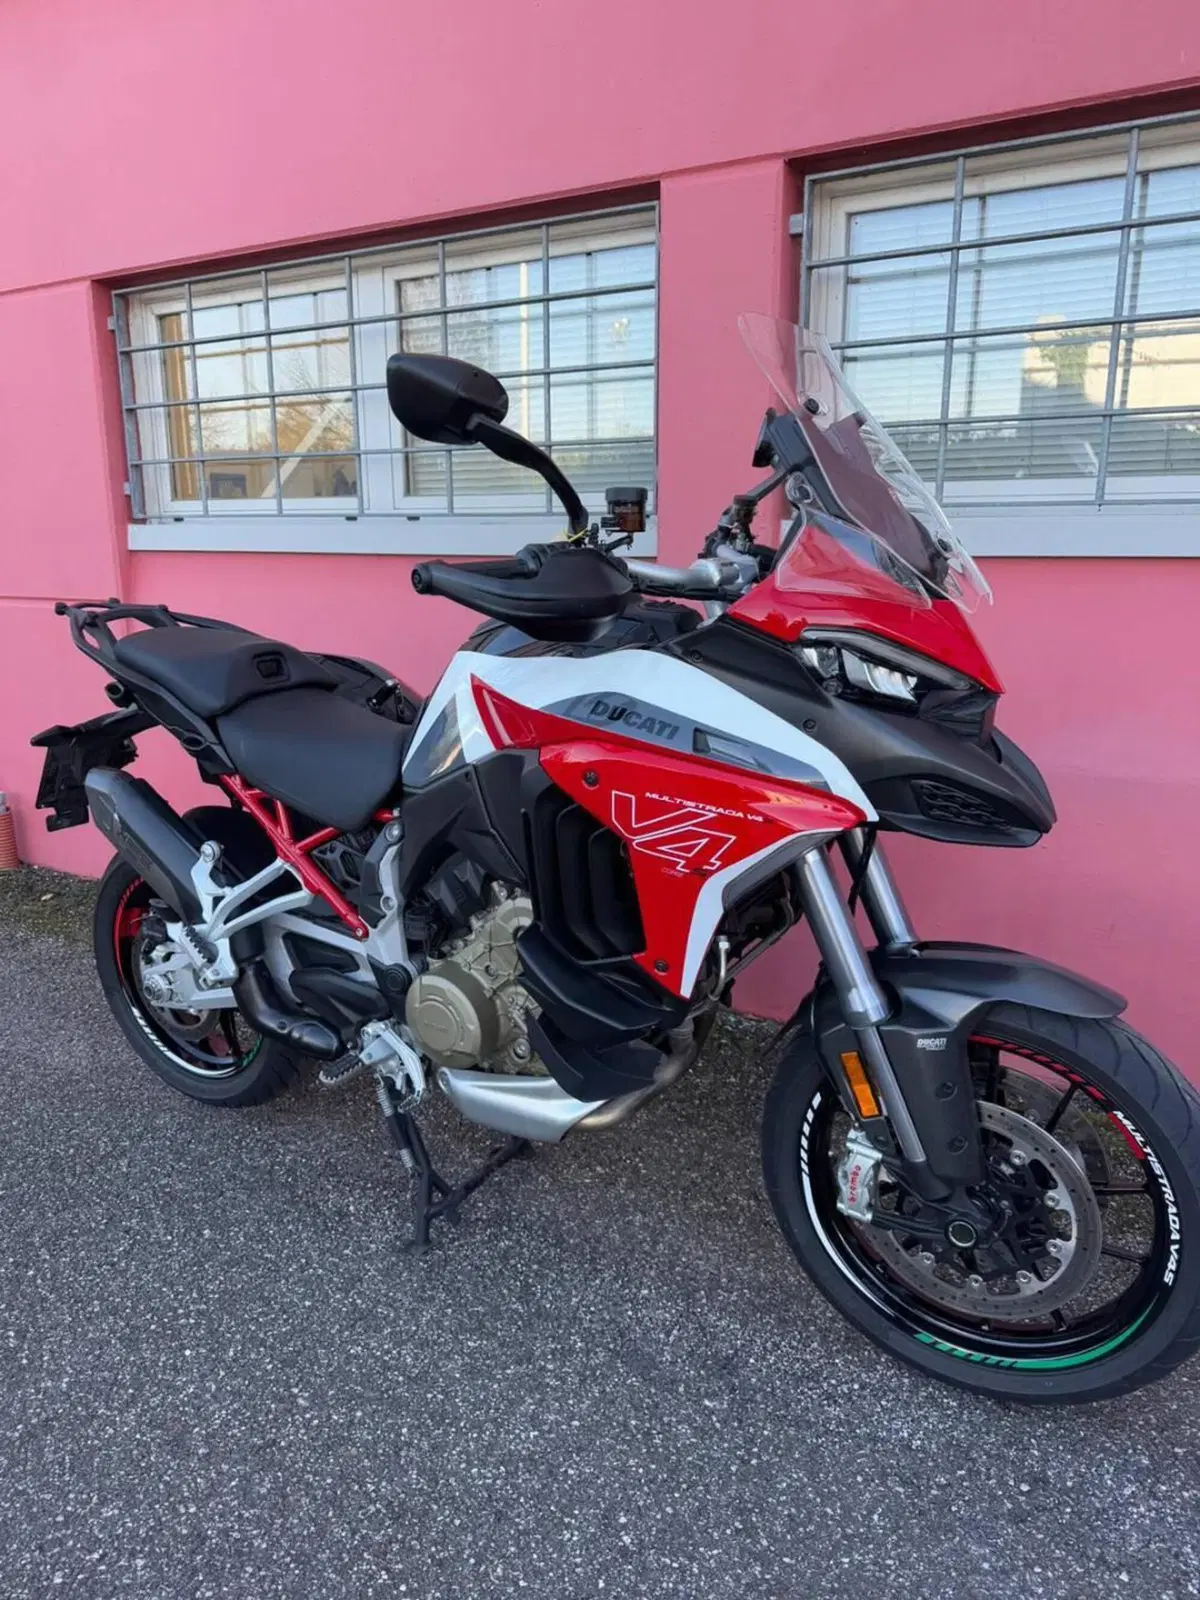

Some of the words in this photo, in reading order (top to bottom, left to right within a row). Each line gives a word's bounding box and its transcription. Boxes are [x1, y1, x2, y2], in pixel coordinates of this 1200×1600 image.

[589, 700, 680, 740] DUCATI
[645, 791, 744, 818] MULTISTRADA
[611, 789, 737, 873] V4
[917, 1038, 947, 1046] DUCATI
[848, 1165, 861, 1204] brembo
[1112, 1110, 1180, 1240] MULTISTRADA
[1163, 1244, 1180, 1287] V4S
